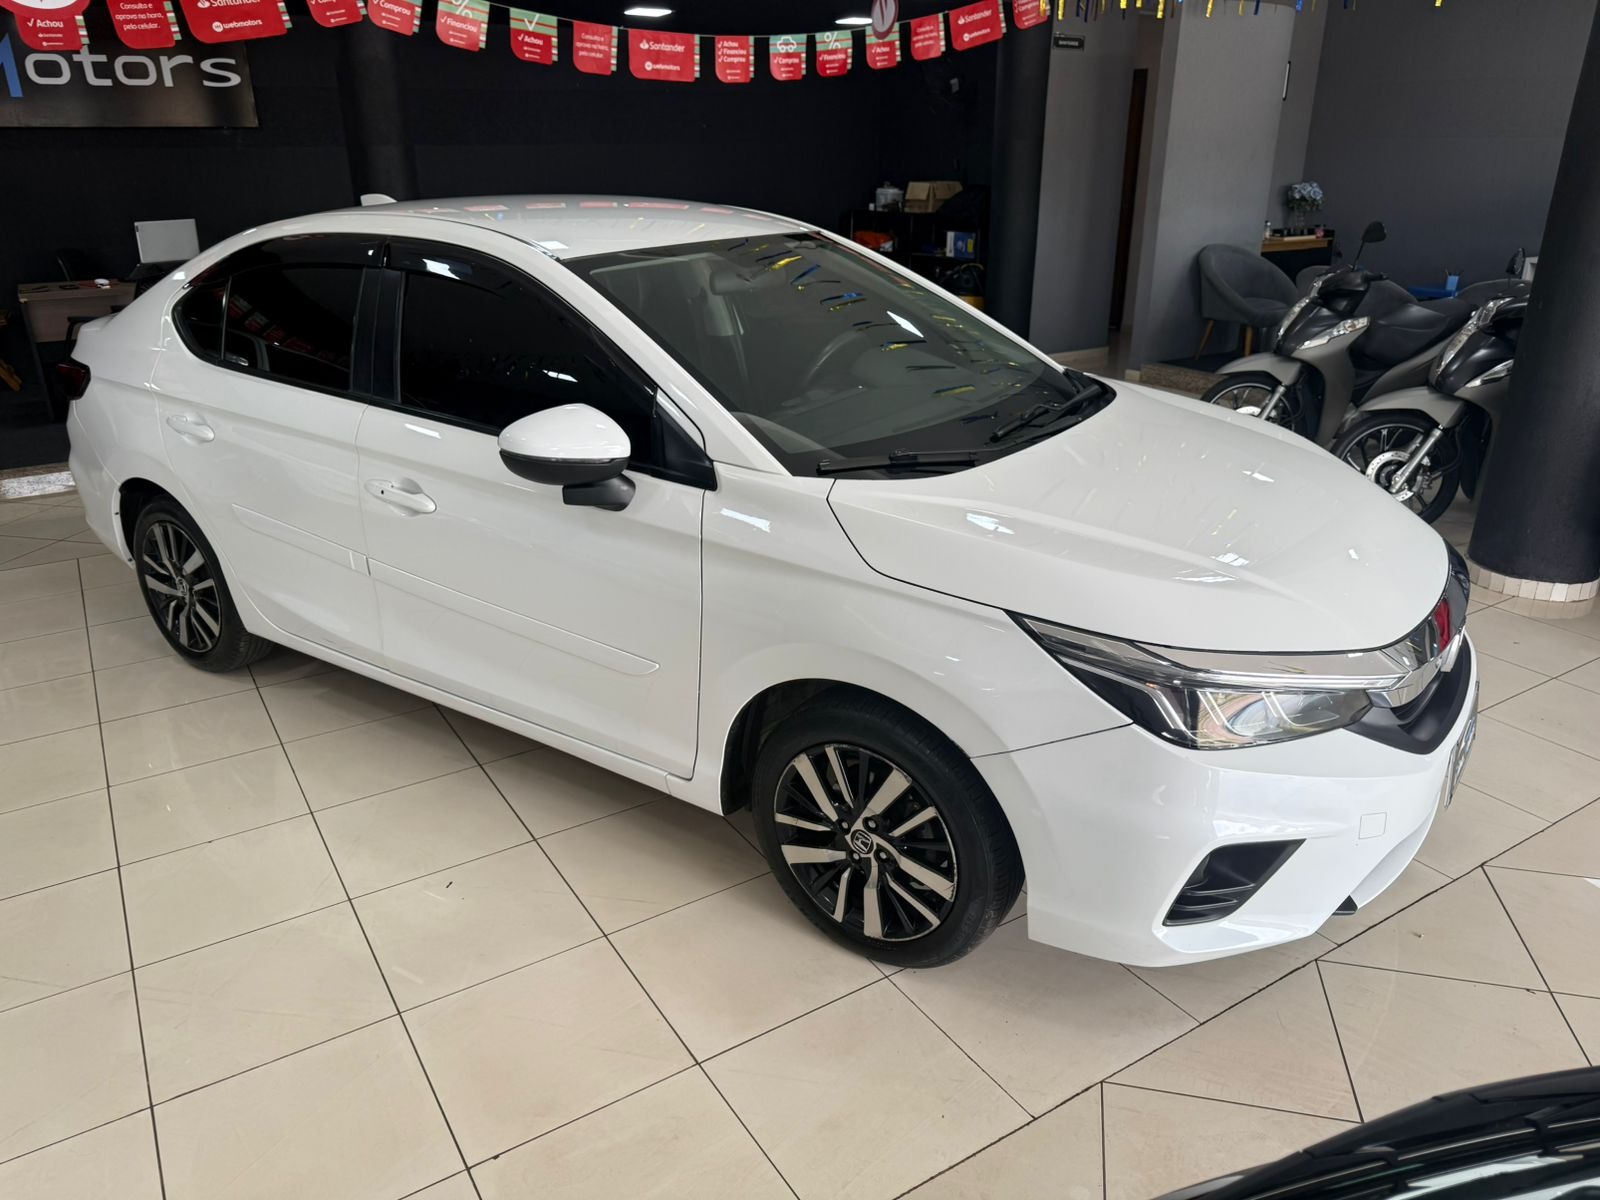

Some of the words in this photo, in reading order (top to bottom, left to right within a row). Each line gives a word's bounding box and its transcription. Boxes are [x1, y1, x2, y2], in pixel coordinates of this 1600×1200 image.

[120, 2, 147, 10] Consulta
[380, 0, 411, 15] Comprou
[964, 9, 992, 24] Santander
[36, 19, 64, 28] Achou
[123, 23, 137, 31] pelo
[223, 19, 262, 29] webmotors
[447, 17, 477, 32] Financiou
[524, 35, 543, 45] Achou
[649, 41, 685, 52] Santander
